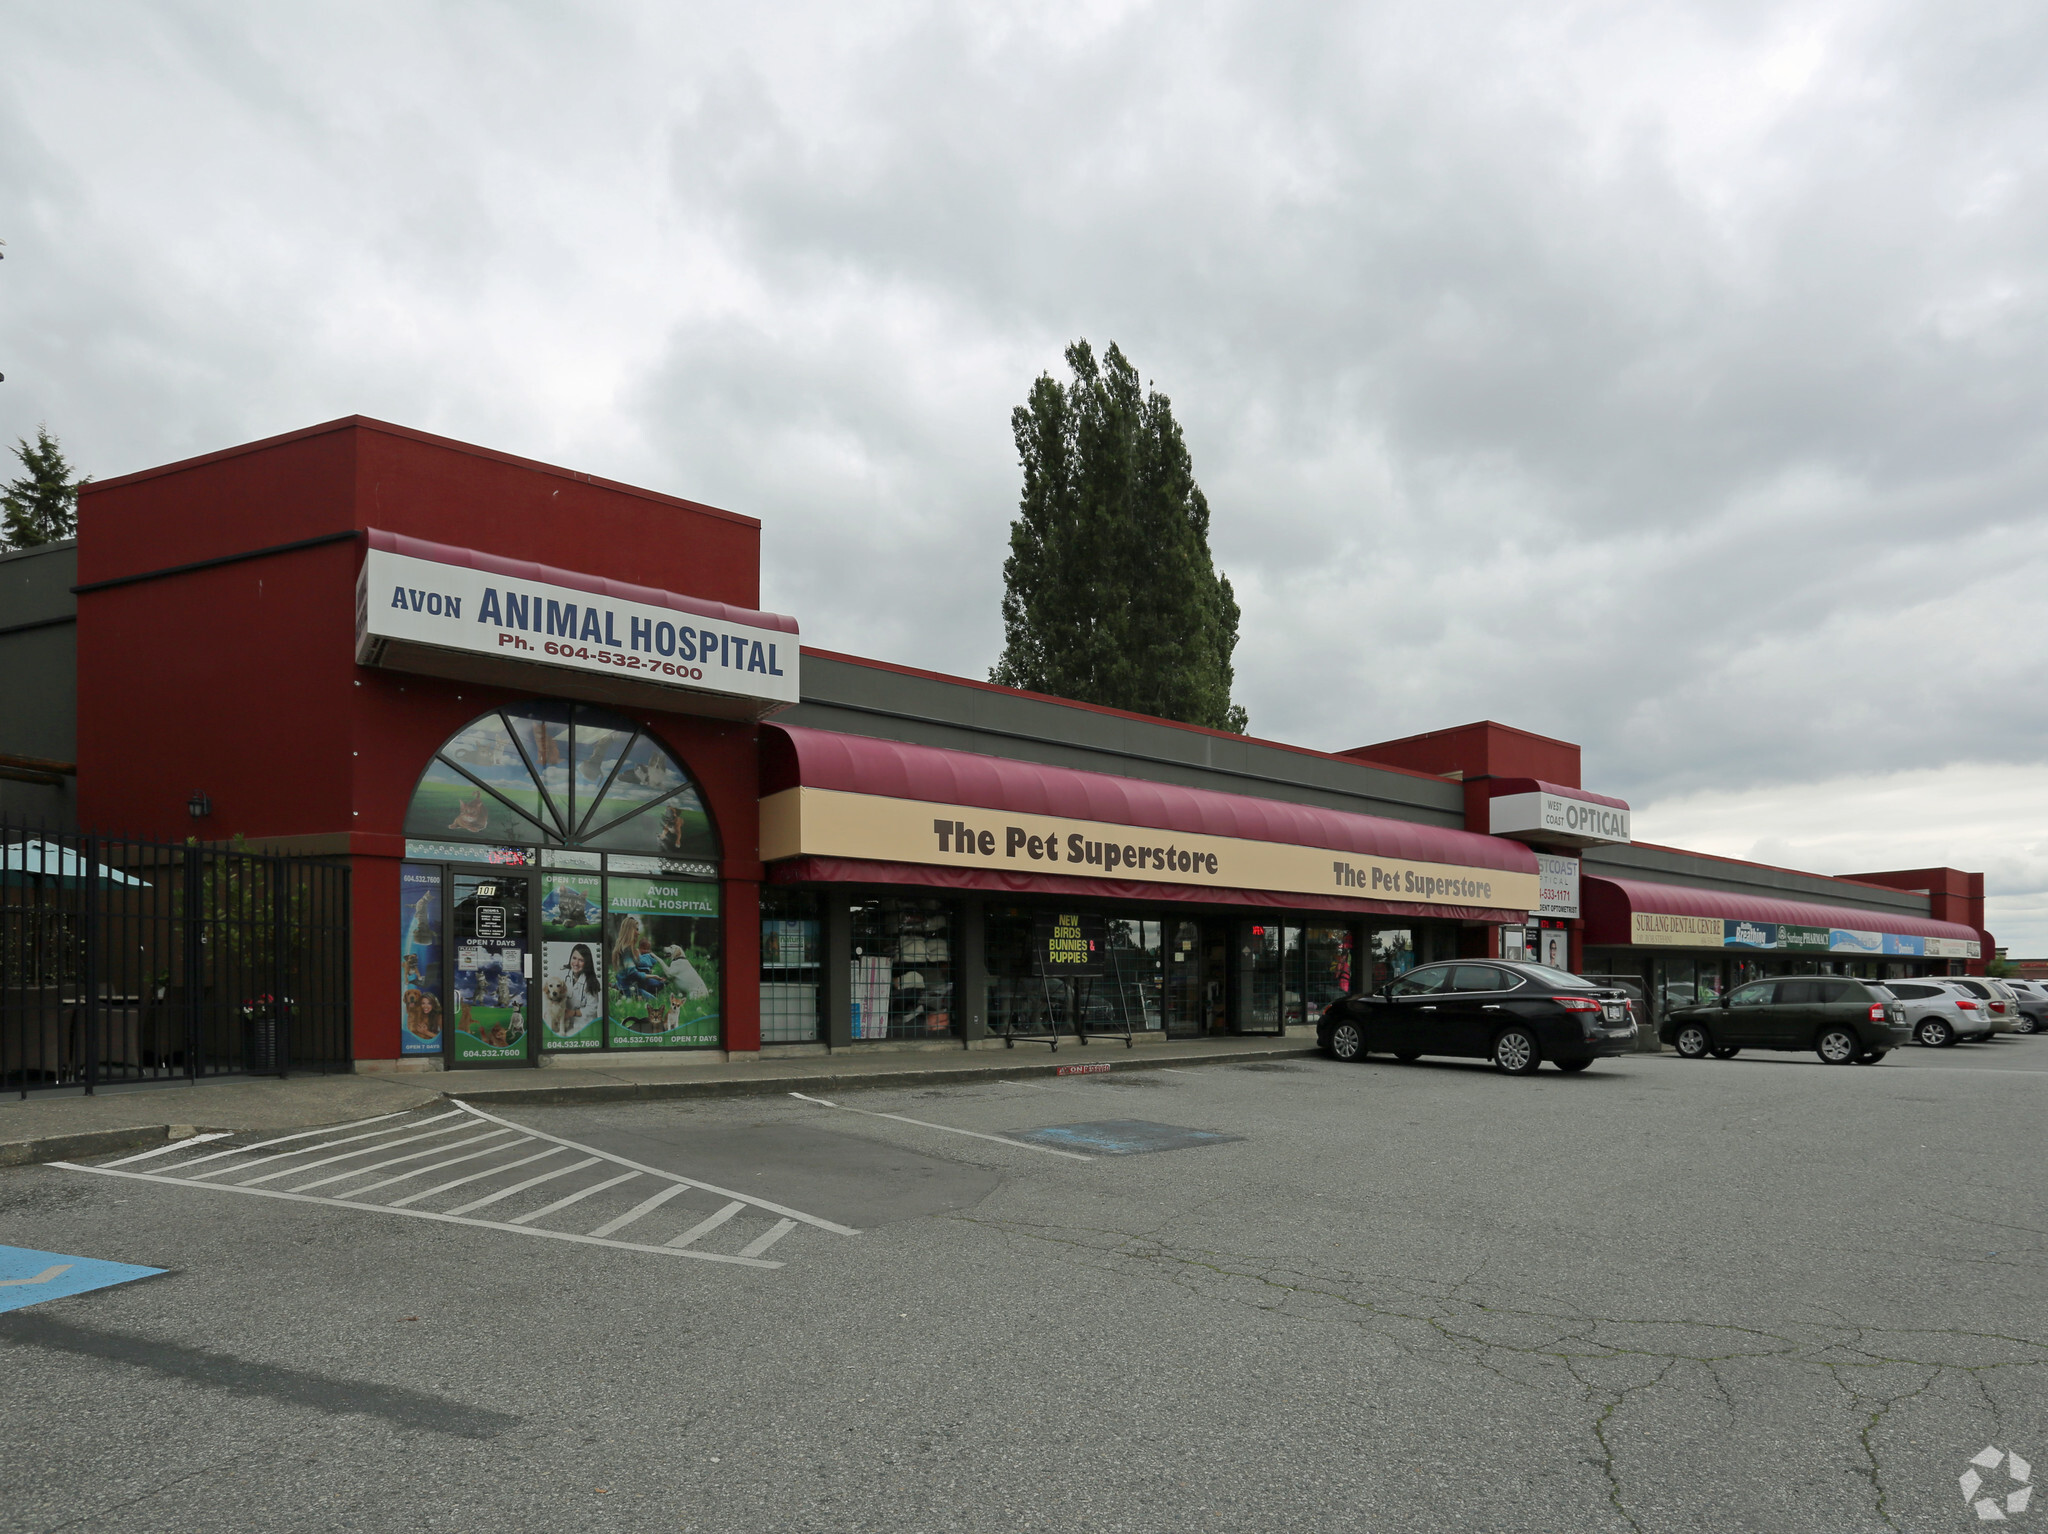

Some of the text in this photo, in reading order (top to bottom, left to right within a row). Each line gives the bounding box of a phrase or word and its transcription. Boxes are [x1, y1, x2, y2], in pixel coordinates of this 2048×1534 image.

[391, 586, 461, 618] AVON
[477, 587, 622, 647] ANIMAL
[630, 616, 784, 676] HOSPITAL
[498, 633, 703, 680] Ph. 604-532-7600
[1547, 800, 1562, 812] WEST
[1546, 814, 1564, 826] COAST
[1566, 805, 1627, 838] OPTICAL
[933, 819, 1219, 875] The Pet Superstore
[404, 875, 440, 883] 604.532.7600
[546, 875, 568, 884] OPEN
[578, 877, 599, 886] DAYS
[1333, 861, 1491, 899] The Pet Superstore
[479, 887, 495, 895] 101
[648, 886, 679, 896] AVON
[1540, 888, 1570, 901] -533-1171
[611, 898, 713, 911] ANIMAL HOSPITAL
[1550, 905, 1577, 914] OPTOMETRIST
[1059, 914, 1079, 926] NEW
[1636, 914, 1721, 935] SURLANG DENTAL CENTRE
[1054, 926, 1081, 938] BIRDS
[1736, 927, 1766, 946] Breathing
[1803, 932, 1829, 945] PHARMACY
[1049, 939, 1096, 951] BUNNIES &
[1049, 951, 1088, 963] PUPPIES
[547, 1040, 600, 1049] 604.532.7600
[613, 1036, 663, 1044] 604.532.7600
[463, 1049, 520, 1058] 604.532.7600
